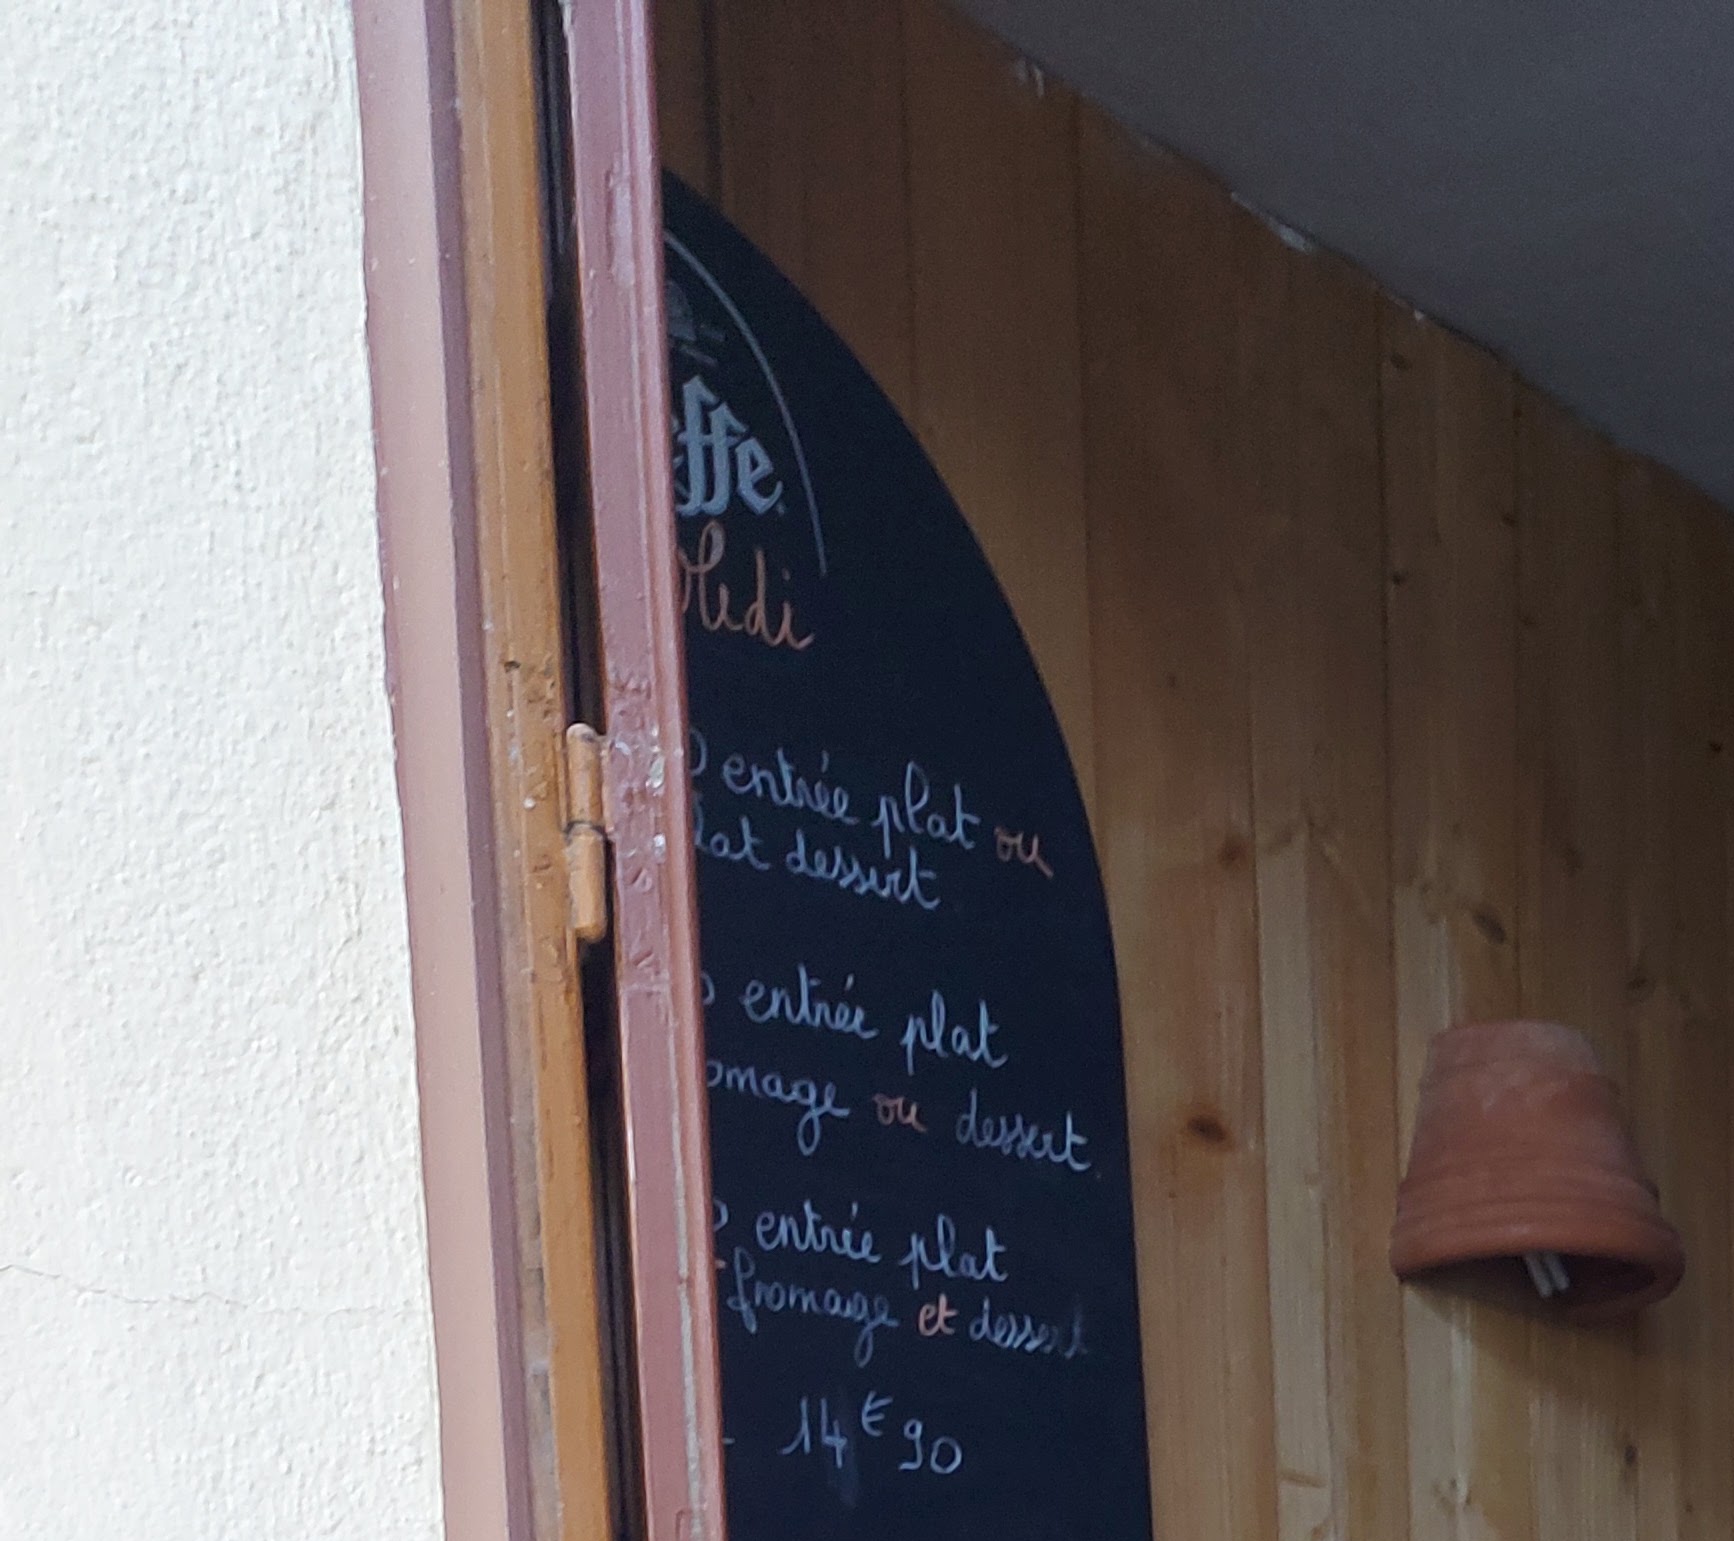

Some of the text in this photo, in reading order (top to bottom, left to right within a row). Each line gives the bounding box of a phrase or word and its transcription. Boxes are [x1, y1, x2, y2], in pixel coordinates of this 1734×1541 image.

[674, 375, 784, 516] ffe
[695, 790, 940, 912] lat dessert
[723, 747, 859, 826] entrée
[873, 760, 981, 860] plat
[994, 826, 1054, 879] ou
[743, 962, 879, 1040] entrée
[900, 989, 1009, 1076] plat
[706, 1059, 1092, 1171] omage ou dessert
[755, 1199, 882, 1264] entrée
[900, 1213, 1009, 1291] plat
[727, 1246, 899, 1368] fromage
[917, 1293, 959, 1337] et
